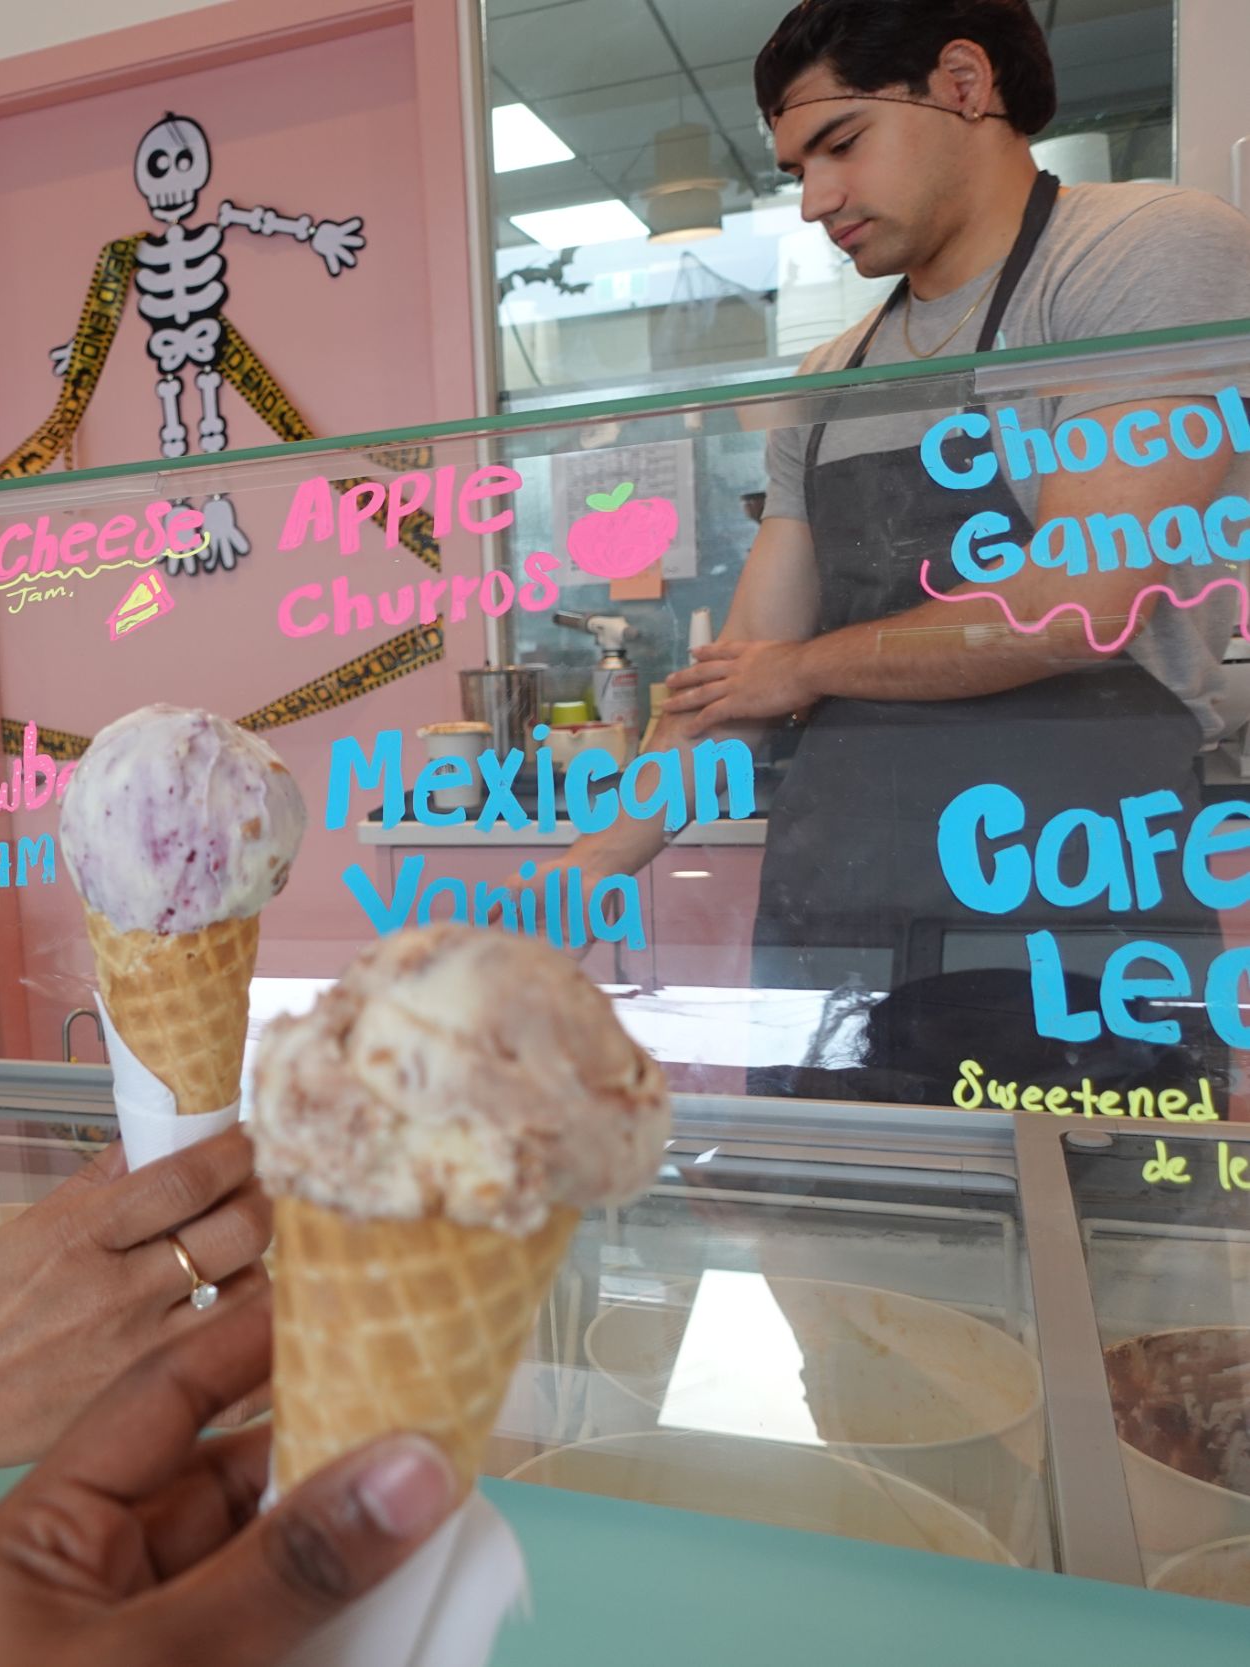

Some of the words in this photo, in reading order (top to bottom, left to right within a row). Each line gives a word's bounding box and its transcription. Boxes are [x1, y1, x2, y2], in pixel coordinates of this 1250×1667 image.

[920, 385, 1250, 490] Chocol
[951, 495, 1250, 584] Ganac
[7, 581, 75, 614] Jam.
[277, 551, 563, 639] Churros
[325, 723, 756, 834] Mexican
[342, 854, 647, 951] Vanilla
[952, 1059, 1219, 1122] Sweetened
[1142, 1139, 1192, 1185] de
